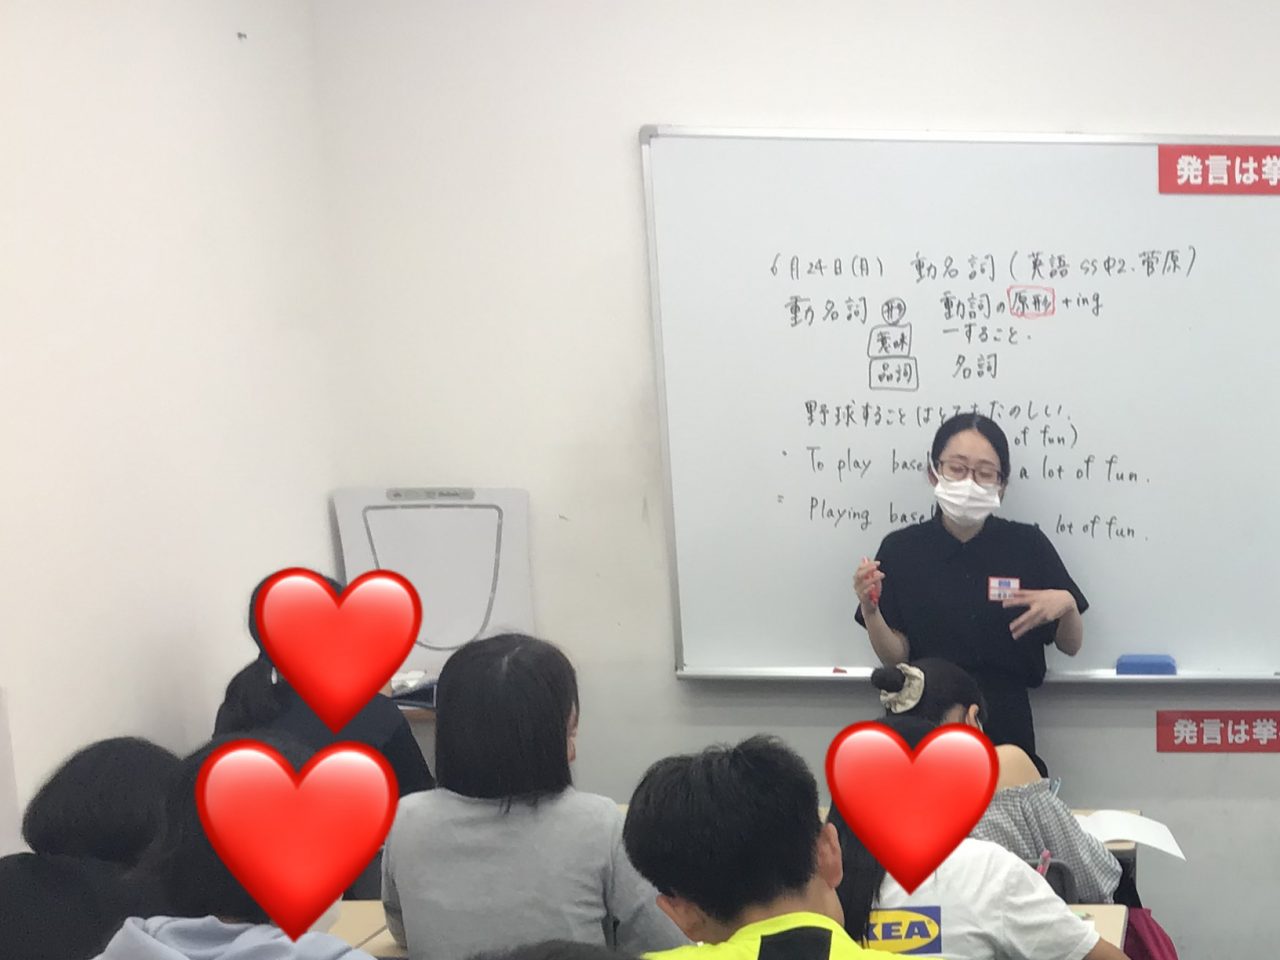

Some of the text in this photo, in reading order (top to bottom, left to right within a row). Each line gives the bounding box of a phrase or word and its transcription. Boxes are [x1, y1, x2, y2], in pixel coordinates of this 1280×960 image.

[785, 295, 868, 327] 動名詞
[953, 353, 998, 379] 名詞
[1014, 426, 1029, 446] of
[806, 446, 824, 472] To
[837, 448, 871, 482] play
[1020, 466, 1029, 480] a
[1043, 455, 1064, 481] lot
[1076, 454, 1095, 481] of
[809, 496, 872, 531] Playing
[1056, 514, 1073, 535] lot
[1083, 515, 1100, 539] of
